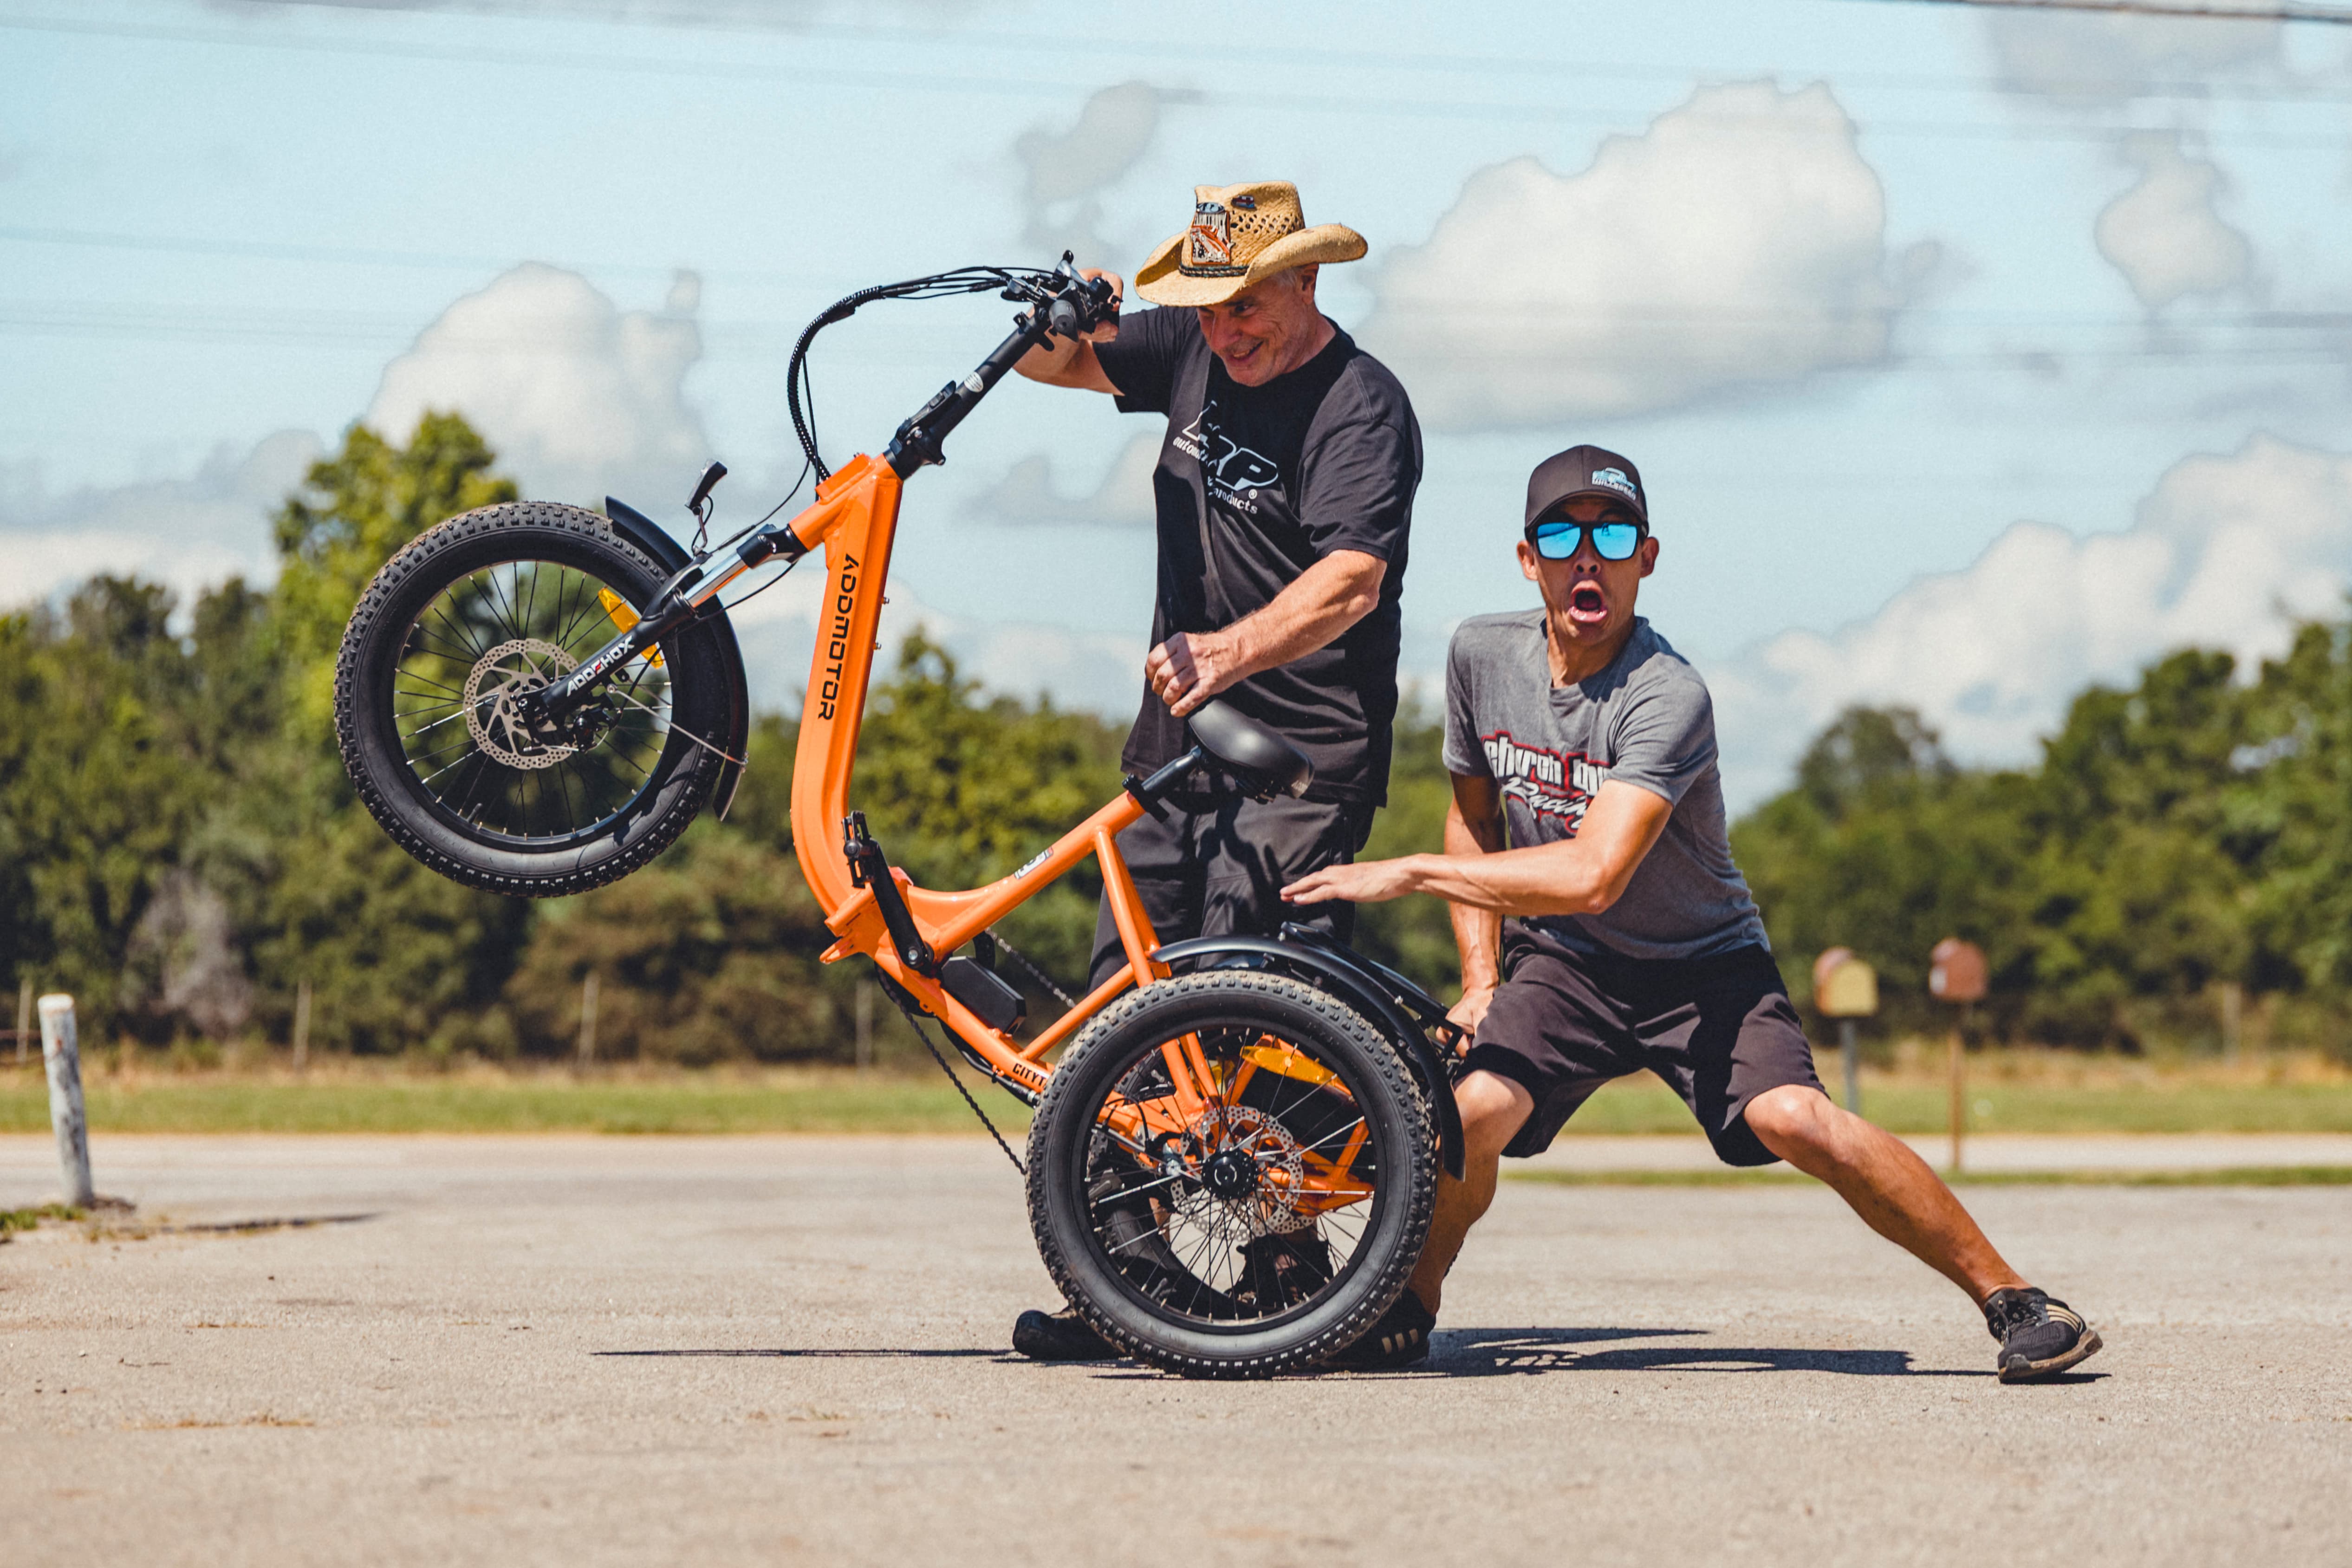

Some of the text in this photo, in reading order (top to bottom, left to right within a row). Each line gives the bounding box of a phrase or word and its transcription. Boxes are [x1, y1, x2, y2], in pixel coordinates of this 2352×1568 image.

[818, 553, 859, 720] ADDMOTOR
[566, 635, 635, 697] ADDSHOX
[1483, 735, 1562, 786] church
[1500, 776, 1586, 828] Racin
[1013, 1062, 1047, 1087] CITYT
